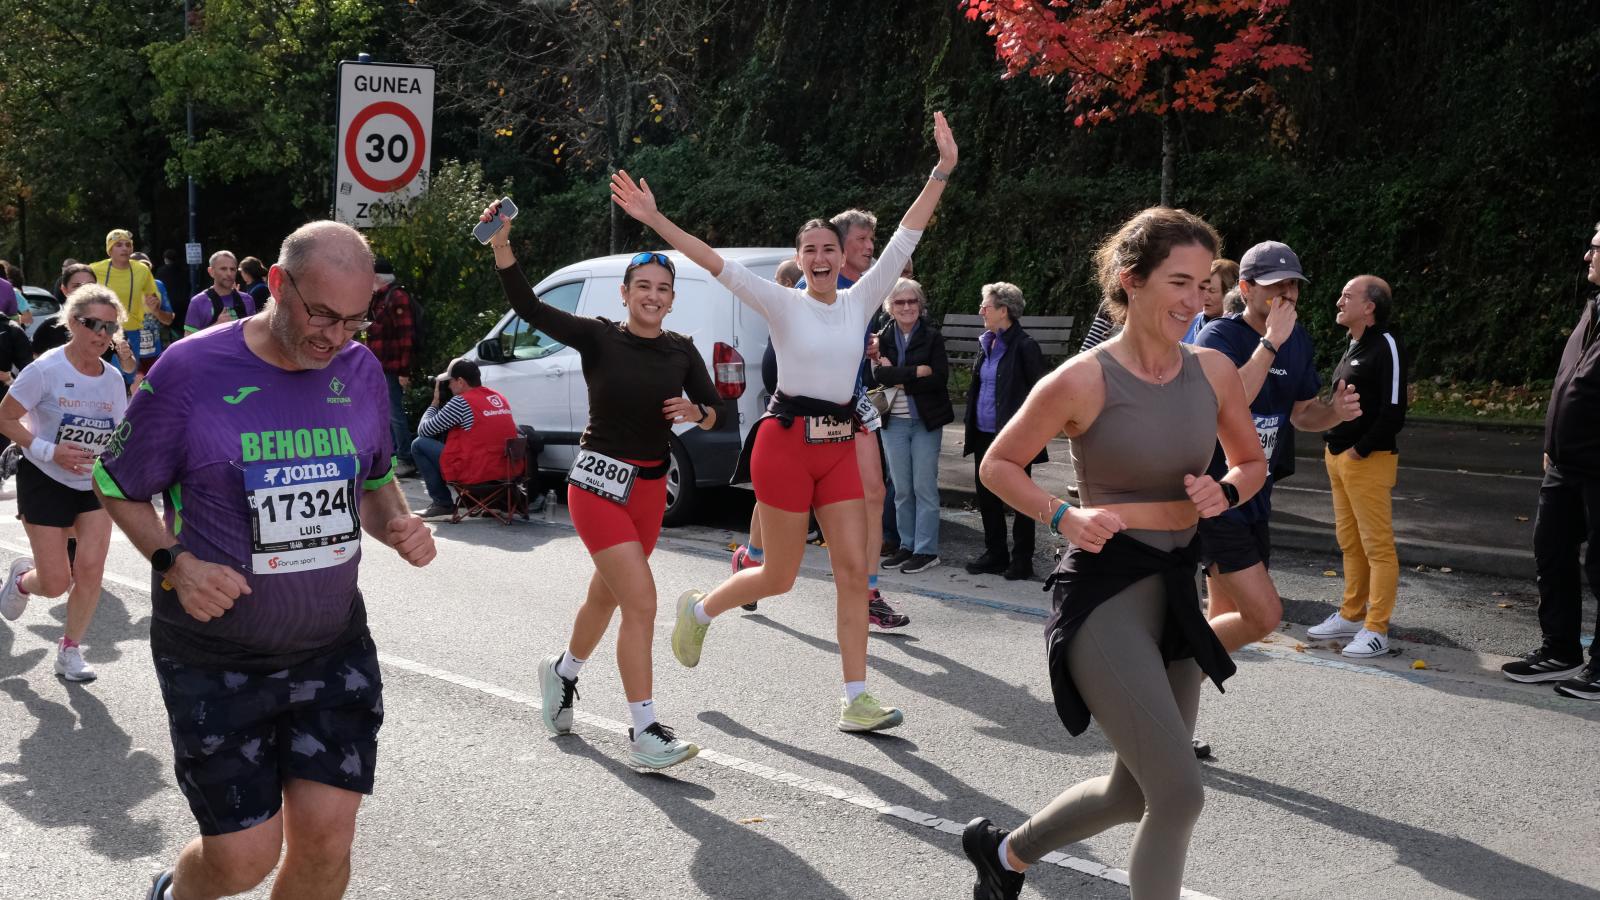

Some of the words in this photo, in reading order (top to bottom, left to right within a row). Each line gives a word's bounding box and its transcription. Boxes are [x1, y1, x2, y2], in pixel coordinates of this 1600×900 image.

[354, 75, 422, 94] GUNEA
[365, 133, 408, 163] 30
[62, 428, 111, 446] 22042
[240, 427, 356, 462] BEHOBIA
[576, 455, 630, 485] 22880
[585, 476, 605, 489] PAULA
[261, 487, 347, 523] 17324
[300, 525, 322, 536] LUIS
